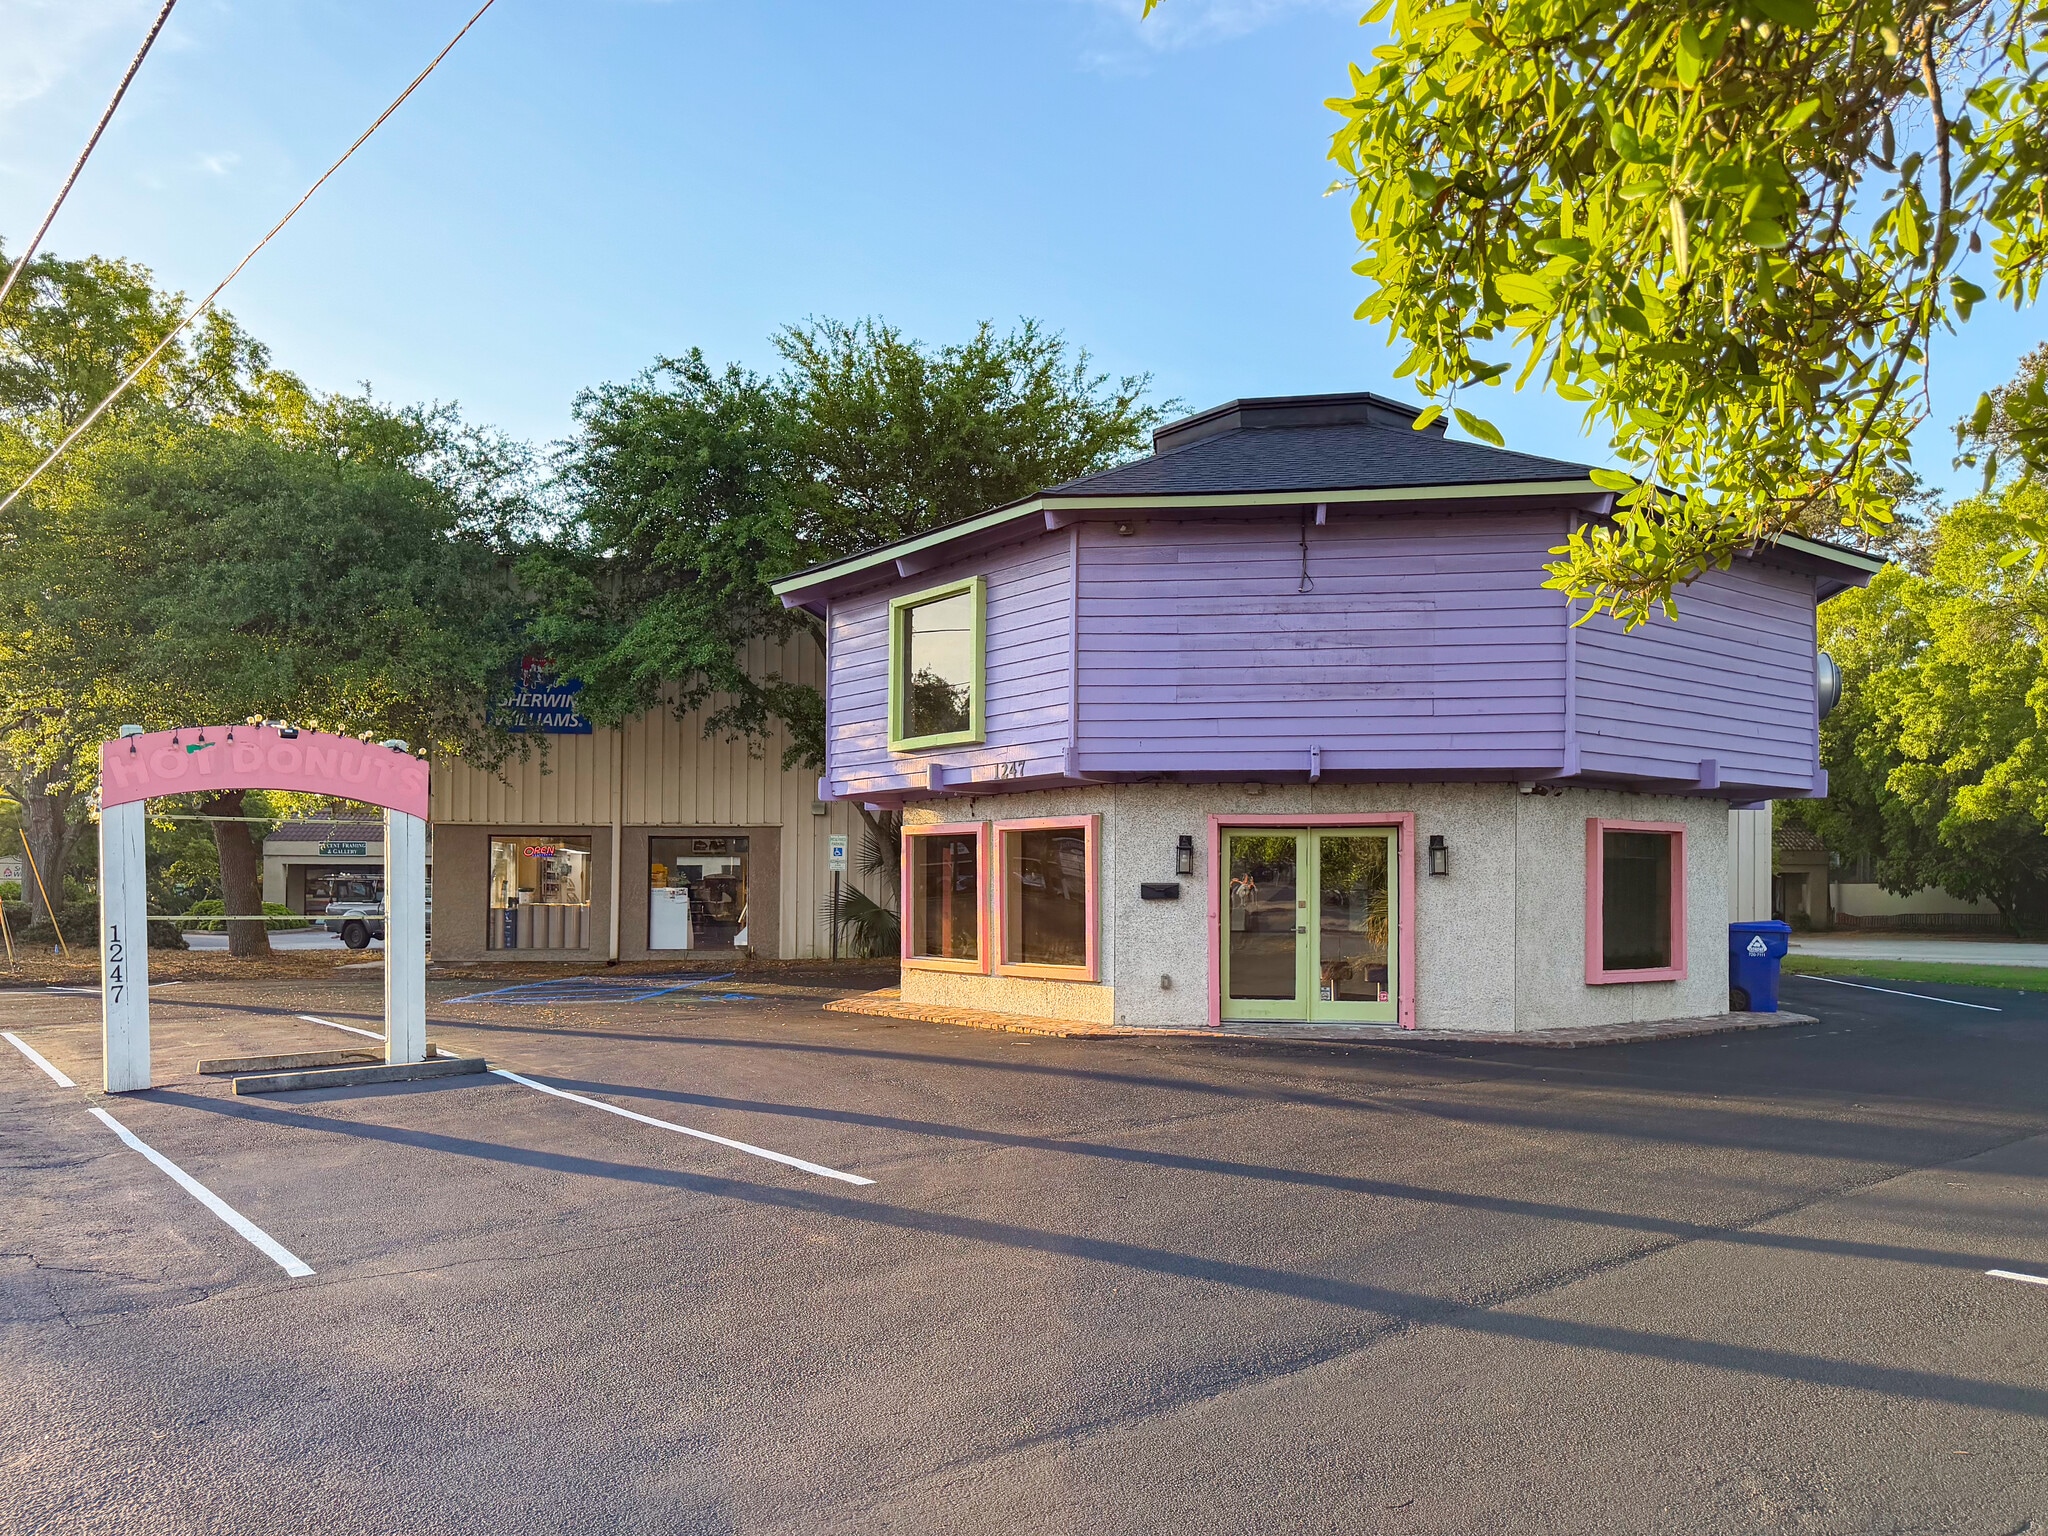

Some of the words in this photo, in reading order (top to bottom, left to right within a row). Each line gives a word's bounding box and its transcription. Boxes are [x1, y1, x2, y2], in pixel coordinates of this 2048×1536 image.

[108, 744, 211, 789] HOT
[232, 743, 424, 796] DONUTS
[994, 760, 1026, 780] 1247
[523, 845, 556, 857] OPEN
[109, 924, 124, 1004] 1247
